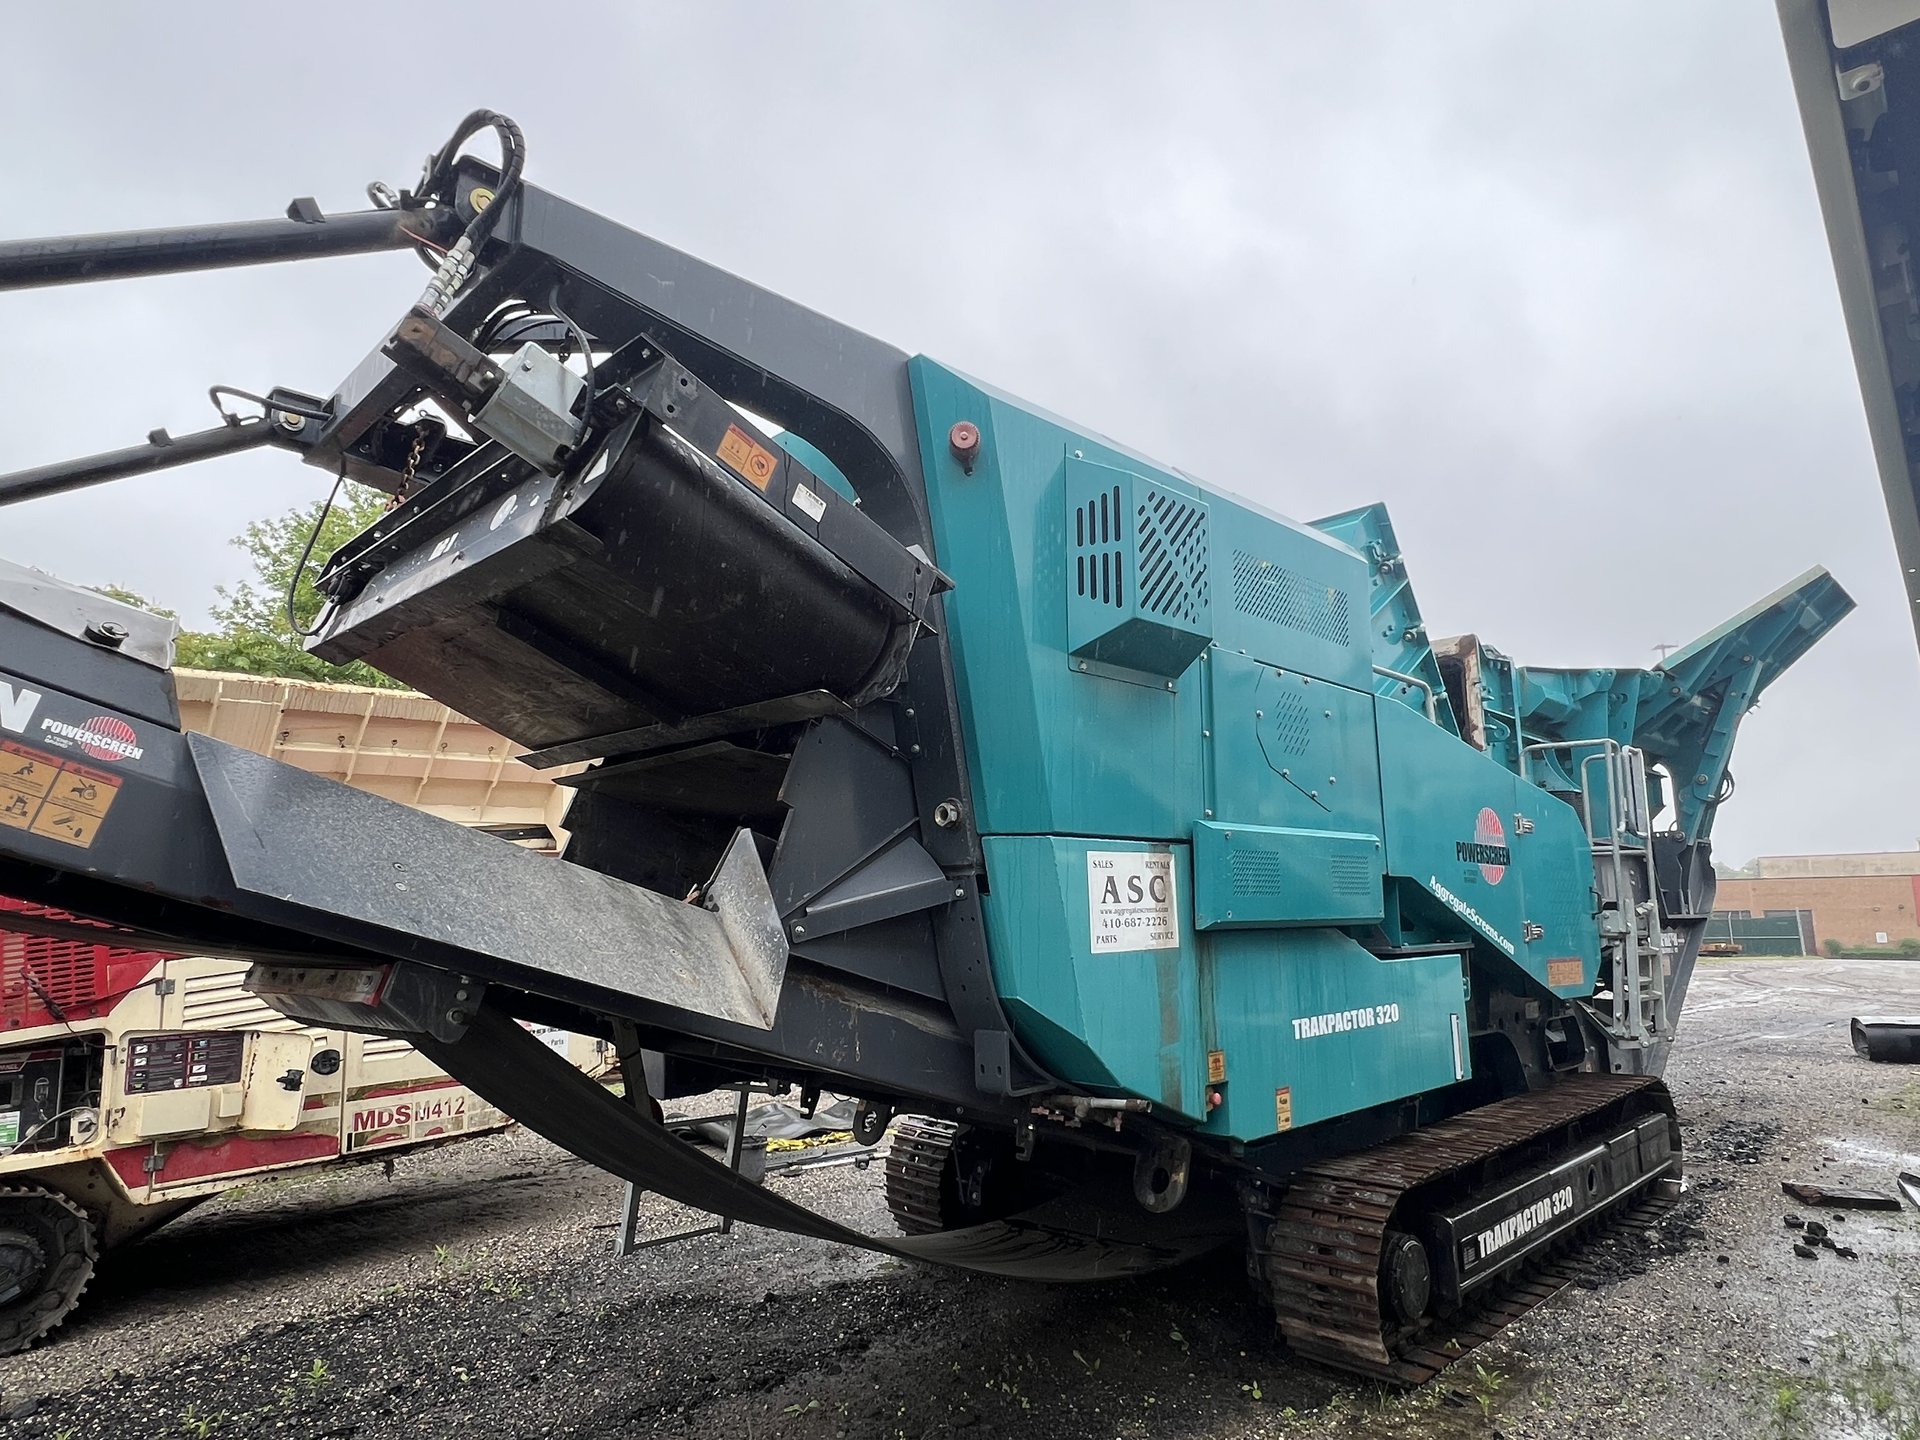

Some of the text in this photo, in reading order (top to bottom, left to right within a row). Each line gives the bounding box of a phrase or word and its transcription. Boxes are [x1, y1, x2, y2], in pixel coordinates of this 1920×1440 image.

[40, 718, 144, 760] POWERSCREEN
[1092, 860, 1171, 870] SALES RENTALS
[1455, 841, 1511, 867] POWERSCREEN
[1102, 916, 1168, 929] 410-687-2226
[1429, 875, 1515, 956] AggregateScreens.com
[1096, 931, 1174, 944] PARTS SERVICE
[1291, 1003, 1400, 1040] TRAKPACTOR 320
[353, 1096, 465, 1132] MDS M412
[1477, 1185, 1573, 1259] TRAKPACTOR 320
